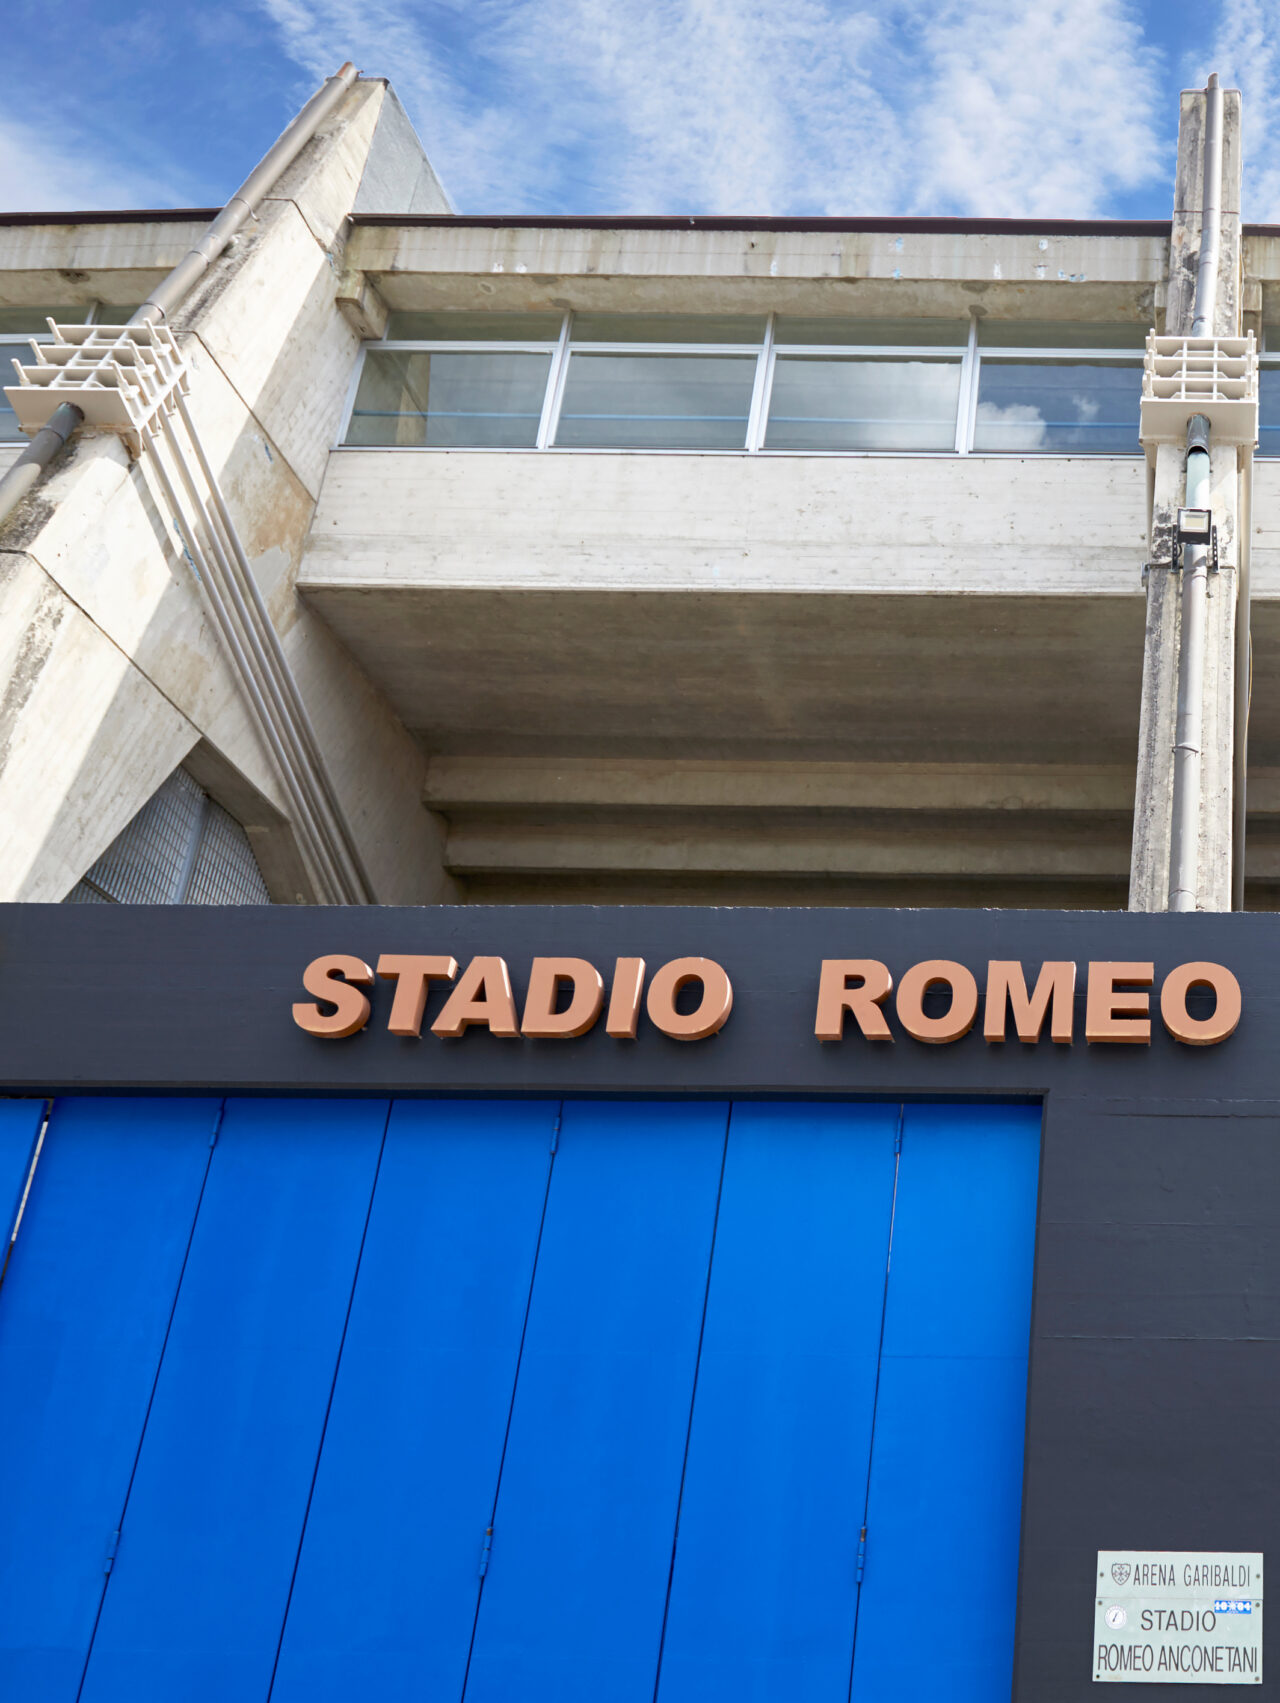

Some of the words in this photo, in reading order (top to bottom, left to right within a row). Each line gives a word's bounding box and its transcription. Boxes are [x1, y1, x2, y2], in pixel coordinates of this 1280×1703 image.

[292, 954, 734, 1041] STADIO
[814, 959, 1242, 1046] ROMEO
[1133, 1563, 1176, 1587] ARENA
[1183, 1564, 1251, 1588] GARIBALDI
[1140, 1609, 1217, 1633] STADIO
[1097, 1643, 1154, 1672] ROMEO
[1157, 1644, 1258, 1673] ANCONETANI
